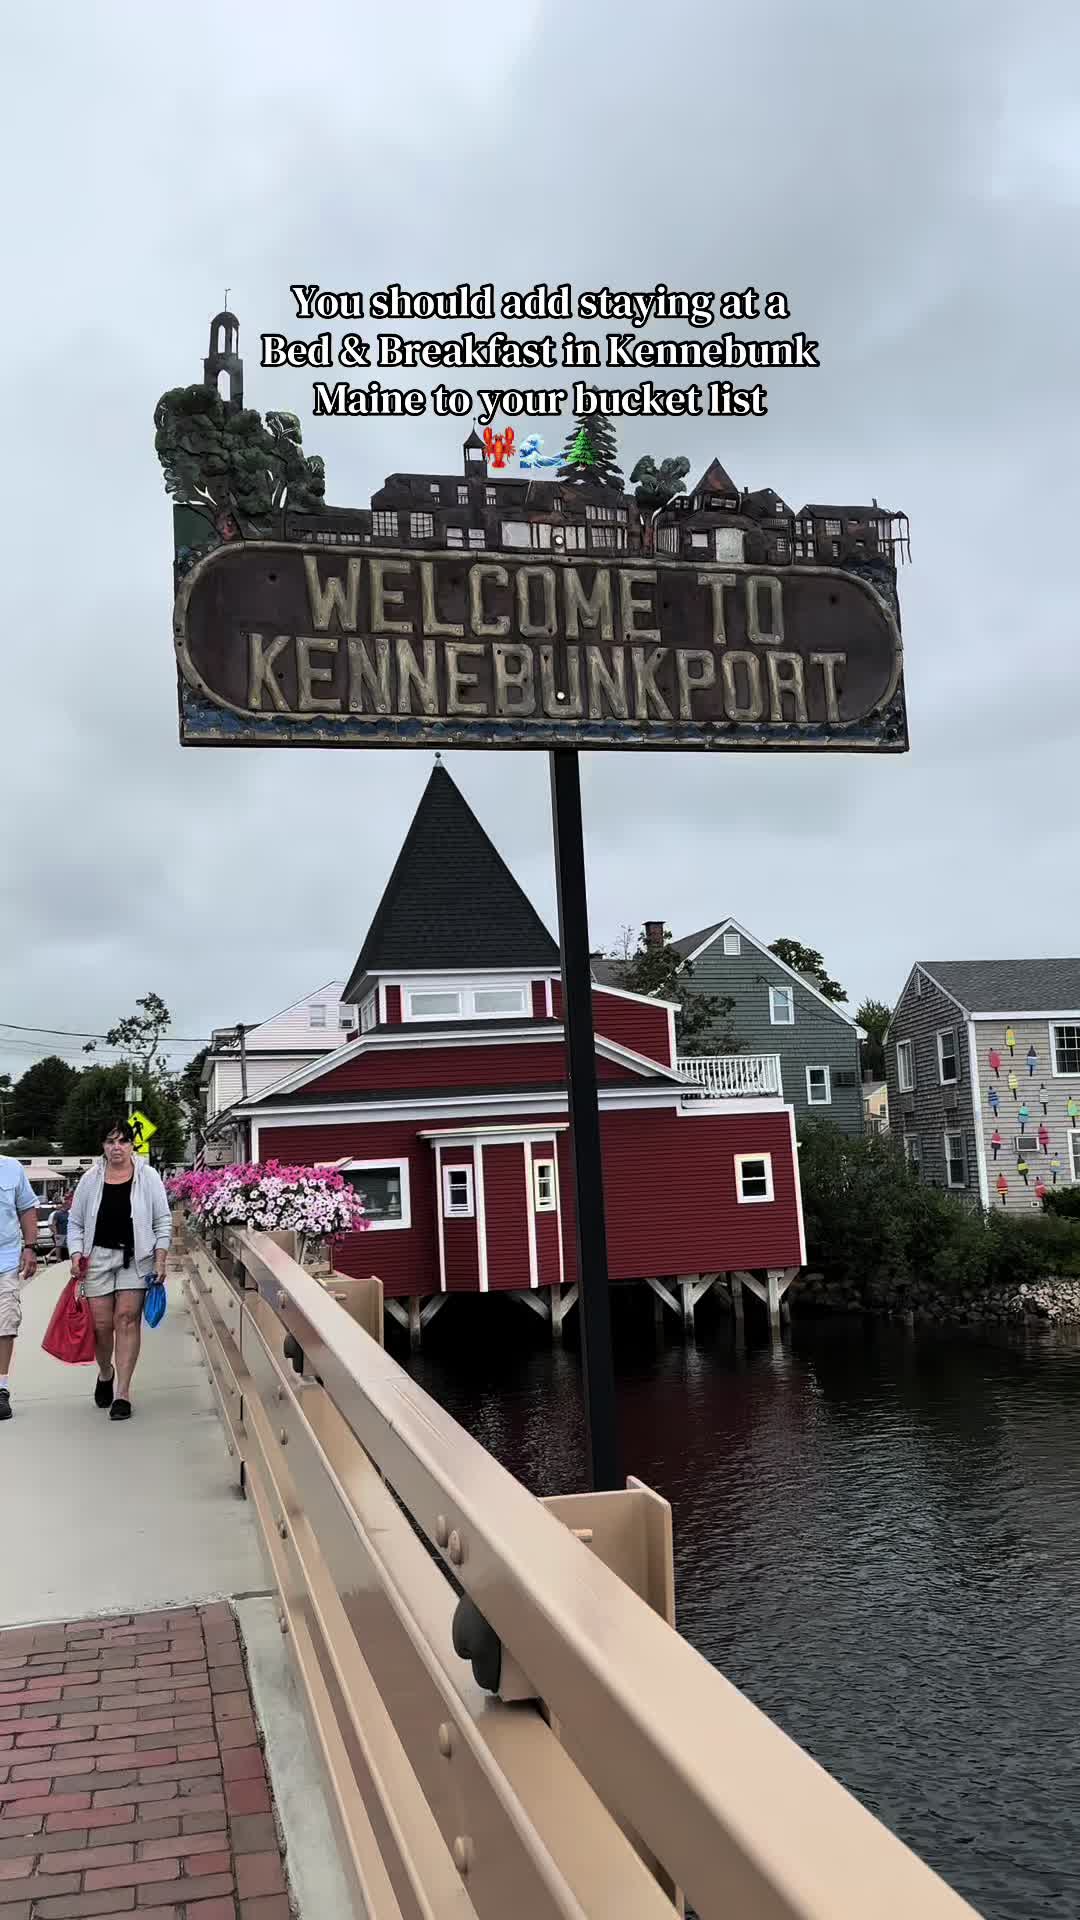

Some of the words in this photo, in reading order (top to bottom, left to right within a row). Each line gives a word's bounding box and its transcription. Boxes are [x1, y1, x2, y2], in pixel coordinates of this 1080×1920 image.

[303, 556, 661, 642] WELCOME
[698, 573, 784, 644] TO
[249, 633, 847, 722] KENNEBUNKPORT
